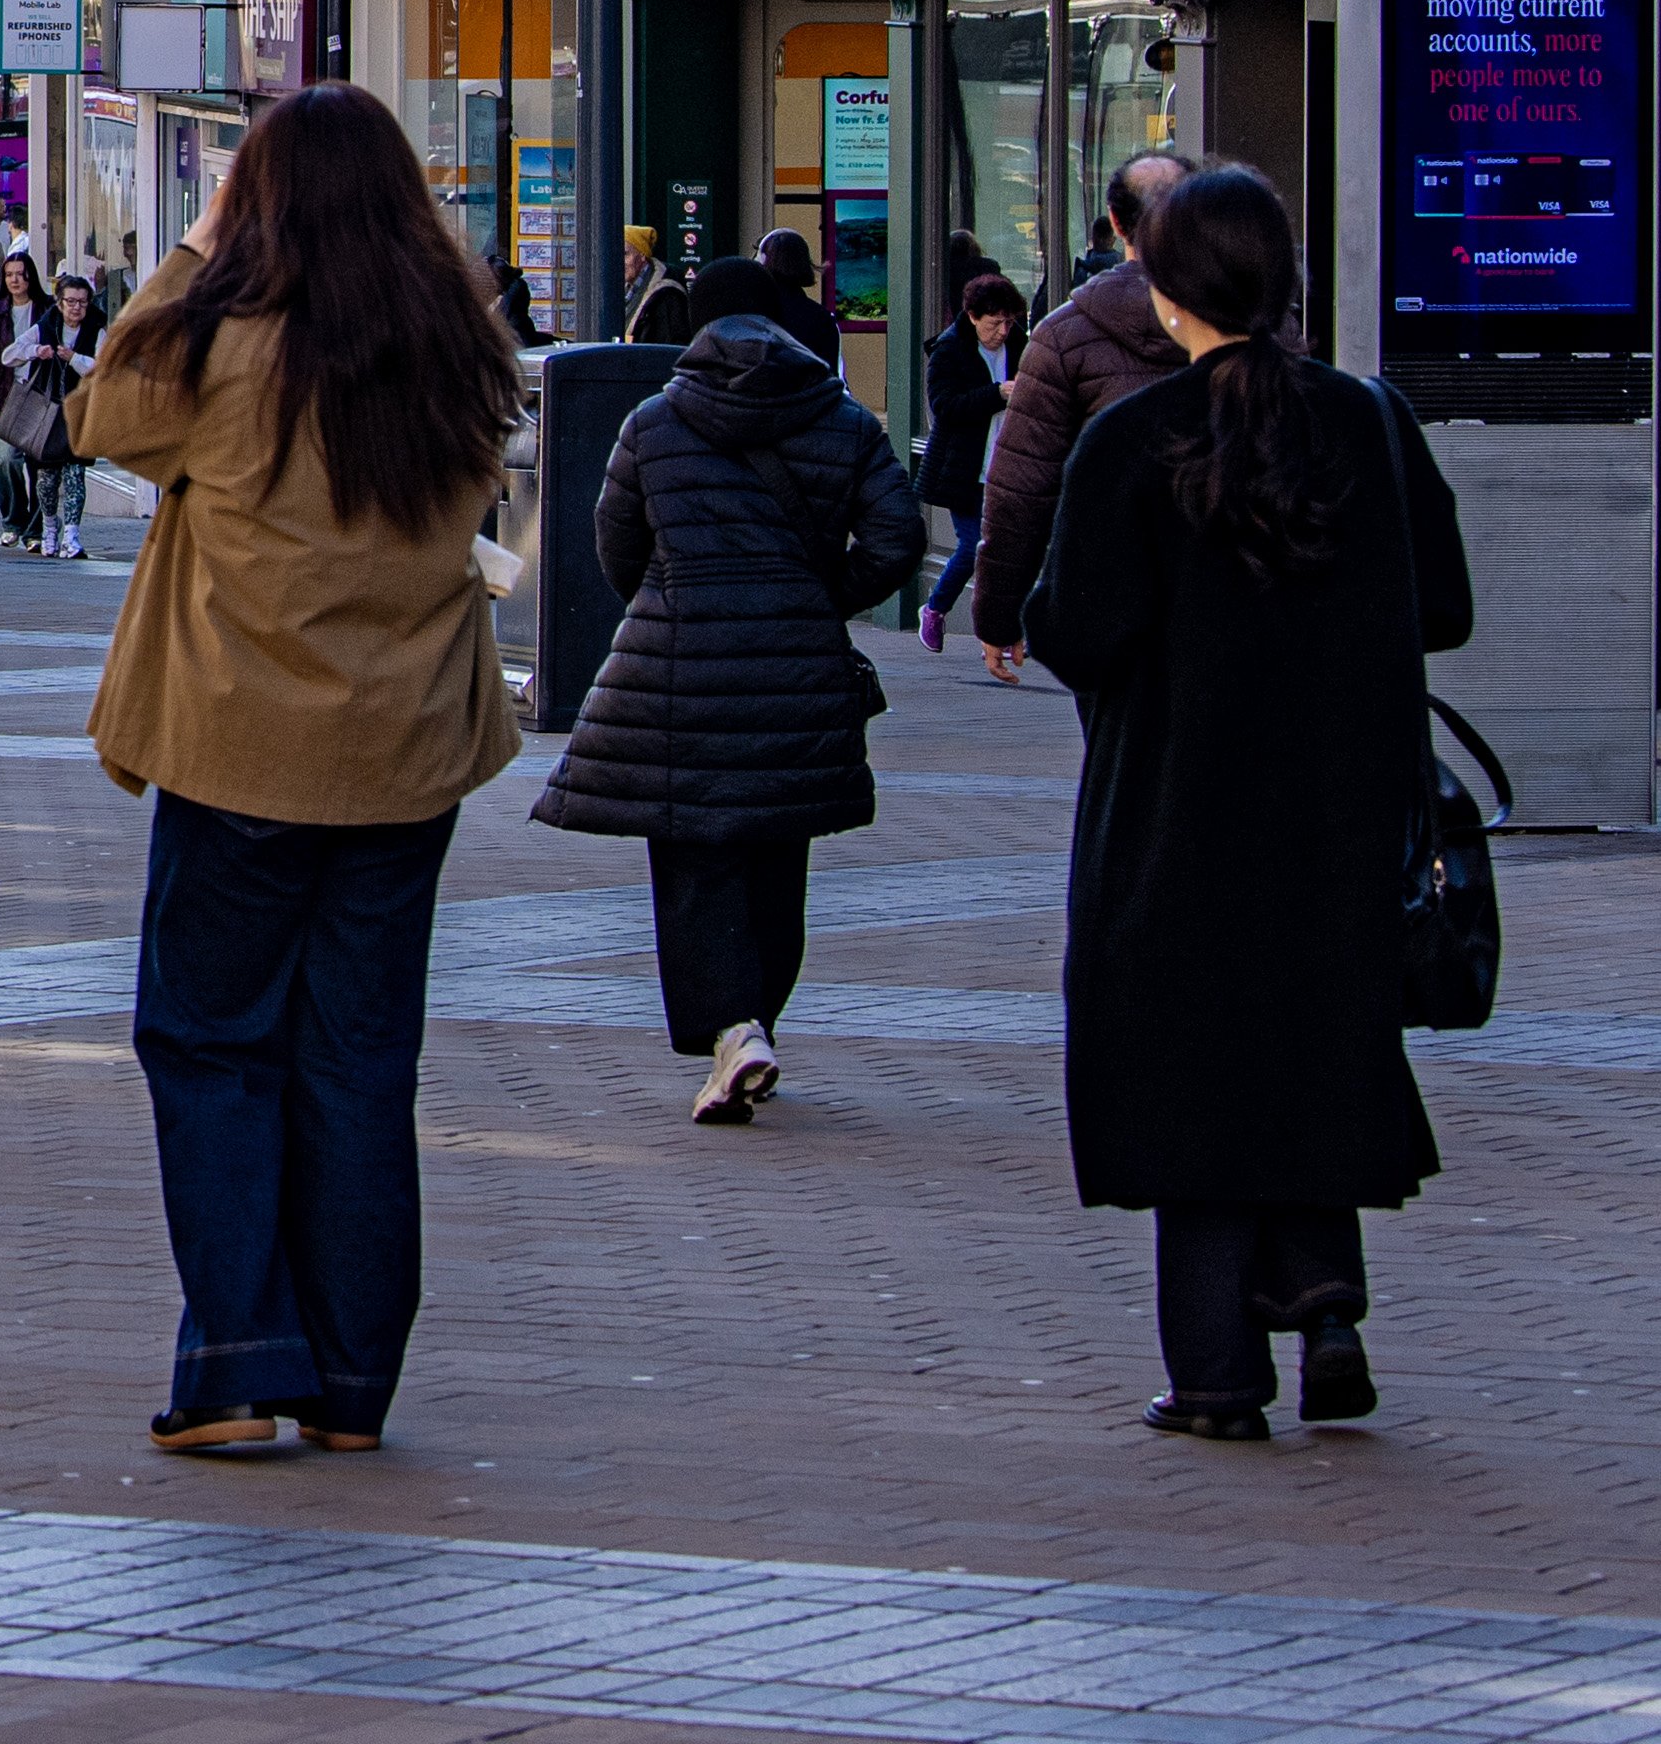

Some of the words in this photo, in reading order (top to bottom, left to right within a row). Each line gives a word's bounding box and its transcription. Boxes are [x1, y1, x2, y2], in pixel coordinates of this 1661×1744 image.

[19, 1, 45, 9] Mobile
[47, 1, 62, 9] Lab
[7, 22, 72, 31] REFURBISHED
[18, 32, 62, 41] IPHONES
[1428, 30, 1537, 56] accounts,
[1544, 34, 1603, 52] more
[1430, 61, 1505, 93] people
[1512, 68, 1571, 87] move
[1579, 65, 1603, 87] to
[836, 89, 889, 105] Corfu
[1448, 103, 1489, 122] one
[1496, 95, 1522, 122] of
[1526, 103, 1583, 122] ours.
[836, 115, 860, 125] Now
[862, 115, 874, 125] fr.
[1477, 156, 1518, 165] nationwide
[1538, 201, 1561, 211] VISA
[1589, 200, 1610, 209] VISA
[1473, 247, 1578, 265] nationwide
